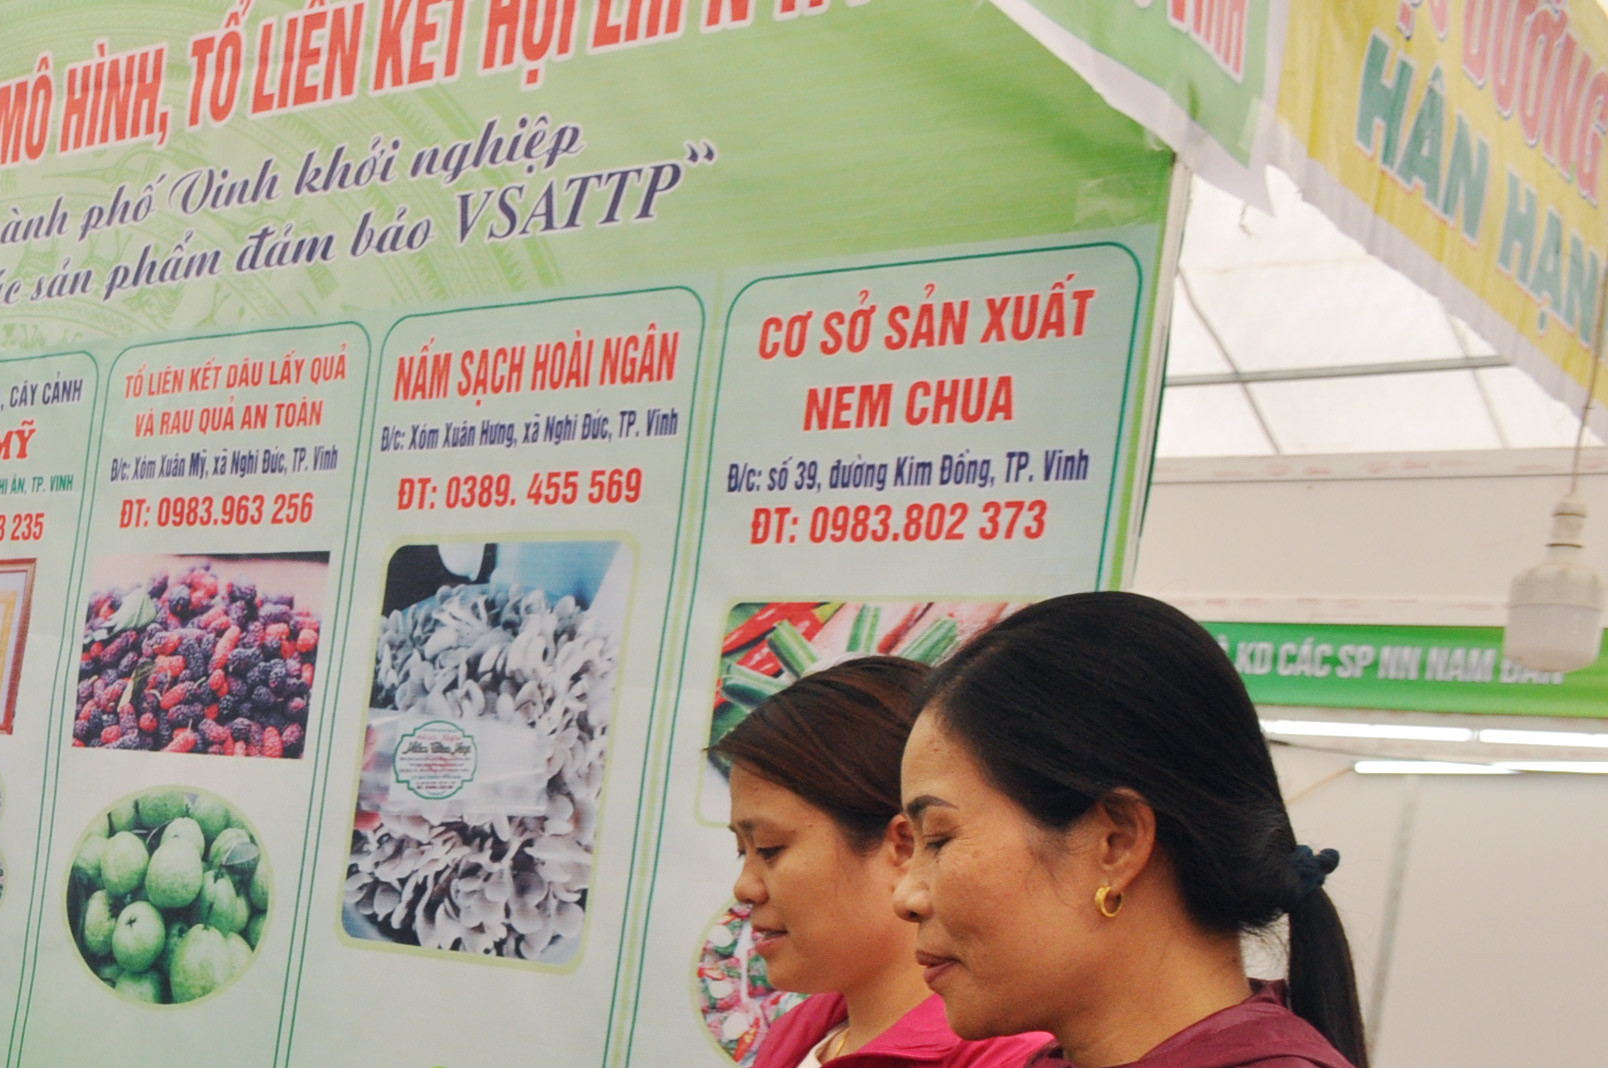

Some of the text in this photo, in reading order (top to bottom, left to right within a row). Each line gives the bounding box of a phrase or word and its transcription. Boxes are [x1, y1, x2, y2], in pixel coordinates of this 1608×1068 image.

[59, 43, 169, 152] HÌNH,
[189, 0, 252, 127] TỔ
[252, 0, 365, 114] LIÊN
[79, 173, 167, 241] phố
[169, 157, 280, 214] Vinh
[294, 136, 398, 196] khởi
[410, 115, 584, 183] nghiệp
[31, 257, 93, 300] sản
[103, 231, 221, 299] phẩm
[236, 222, 337, 272] đảm
[351, 206, 436, 257] bảo
[758, 273, 1096, 360] CƠ SỞ SẢN XUẤT
[125, 342, 347, 399] TỔ LIÊN KẾT DÂU LẤY QUẢ
[394, 322, 679, 407] NẤM SẠCH HOÀI NGÂN
[9, 380, 38, 407] CÂY
[42, 371, 83, 405] CẢNH
[802, 375, 1013, 431] NEM CHUA
[134, 395, 323, 438] VÀ RAU QUẢ AN TOÀN
[408, 407, 679, 450] Xóm Xuân Nghi TP. Vinh
[397, 467, 643, 510] ĐT: 0389. 455 569
[727, 449, 1090, 493] Đ/c: số 39, đường Kim Đồng, TP. Vinh
[10, 512, 45, 541] 235
[119, 492, 314, 529] ĐT: 0983.963 256
[750, 499, 1048, 545] ĐT: 0983.802 373
[1236, 641, 1274, 675] KD
[1278, 636, 1334, 677] CÁC
[1336, 644, 1375, 680] SP
[1426, 647, 1497, 683] NAM
